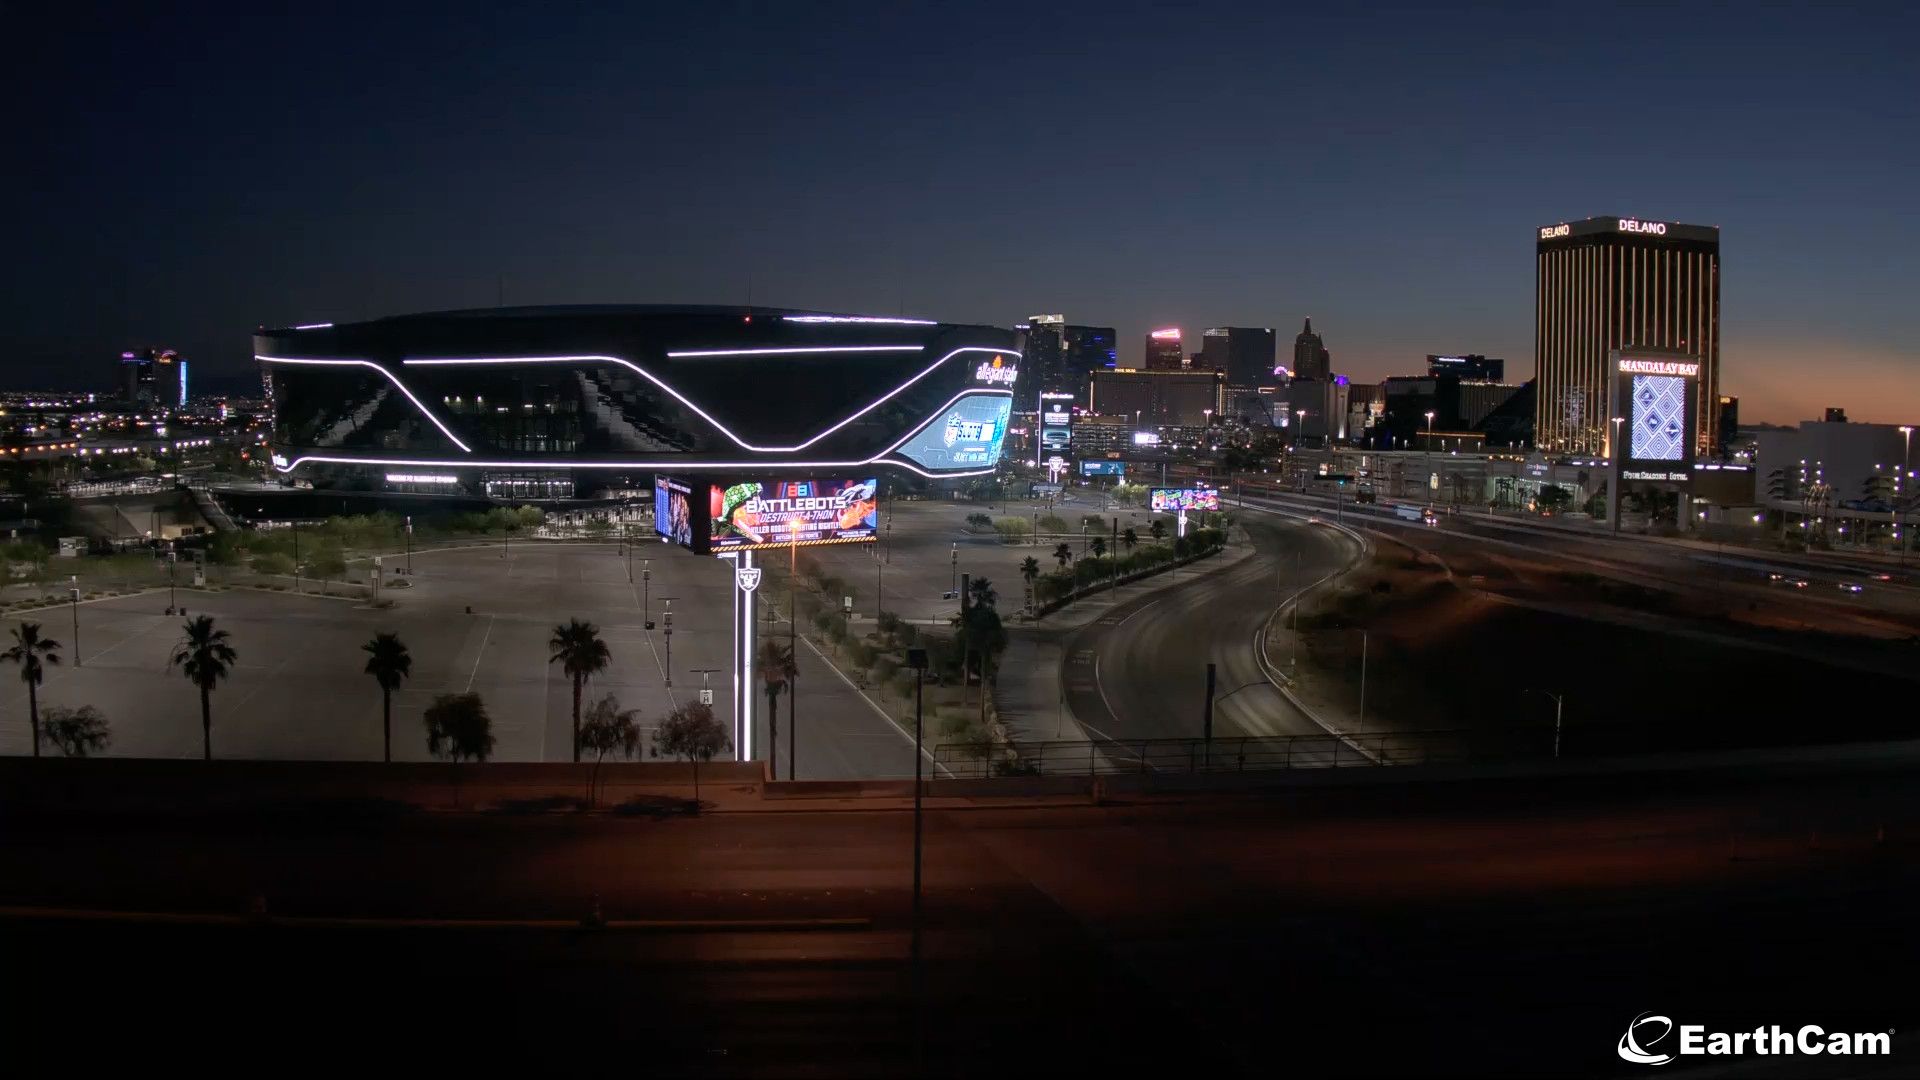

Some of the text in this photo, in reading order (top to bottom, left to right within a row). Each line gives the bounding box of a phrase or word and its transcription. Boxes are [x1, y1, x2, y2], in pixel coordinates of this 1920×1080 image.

[1541, 224, 1570, 239] DELANO
[1619, 219, 1666, 235] DELANO
[1619, 360, 1699, 376] MANDALAY BAY
[746, 497, 847, 514] BATTLEBOTS
[760, 509, 834, 523] DESTRUCT-A-THON
